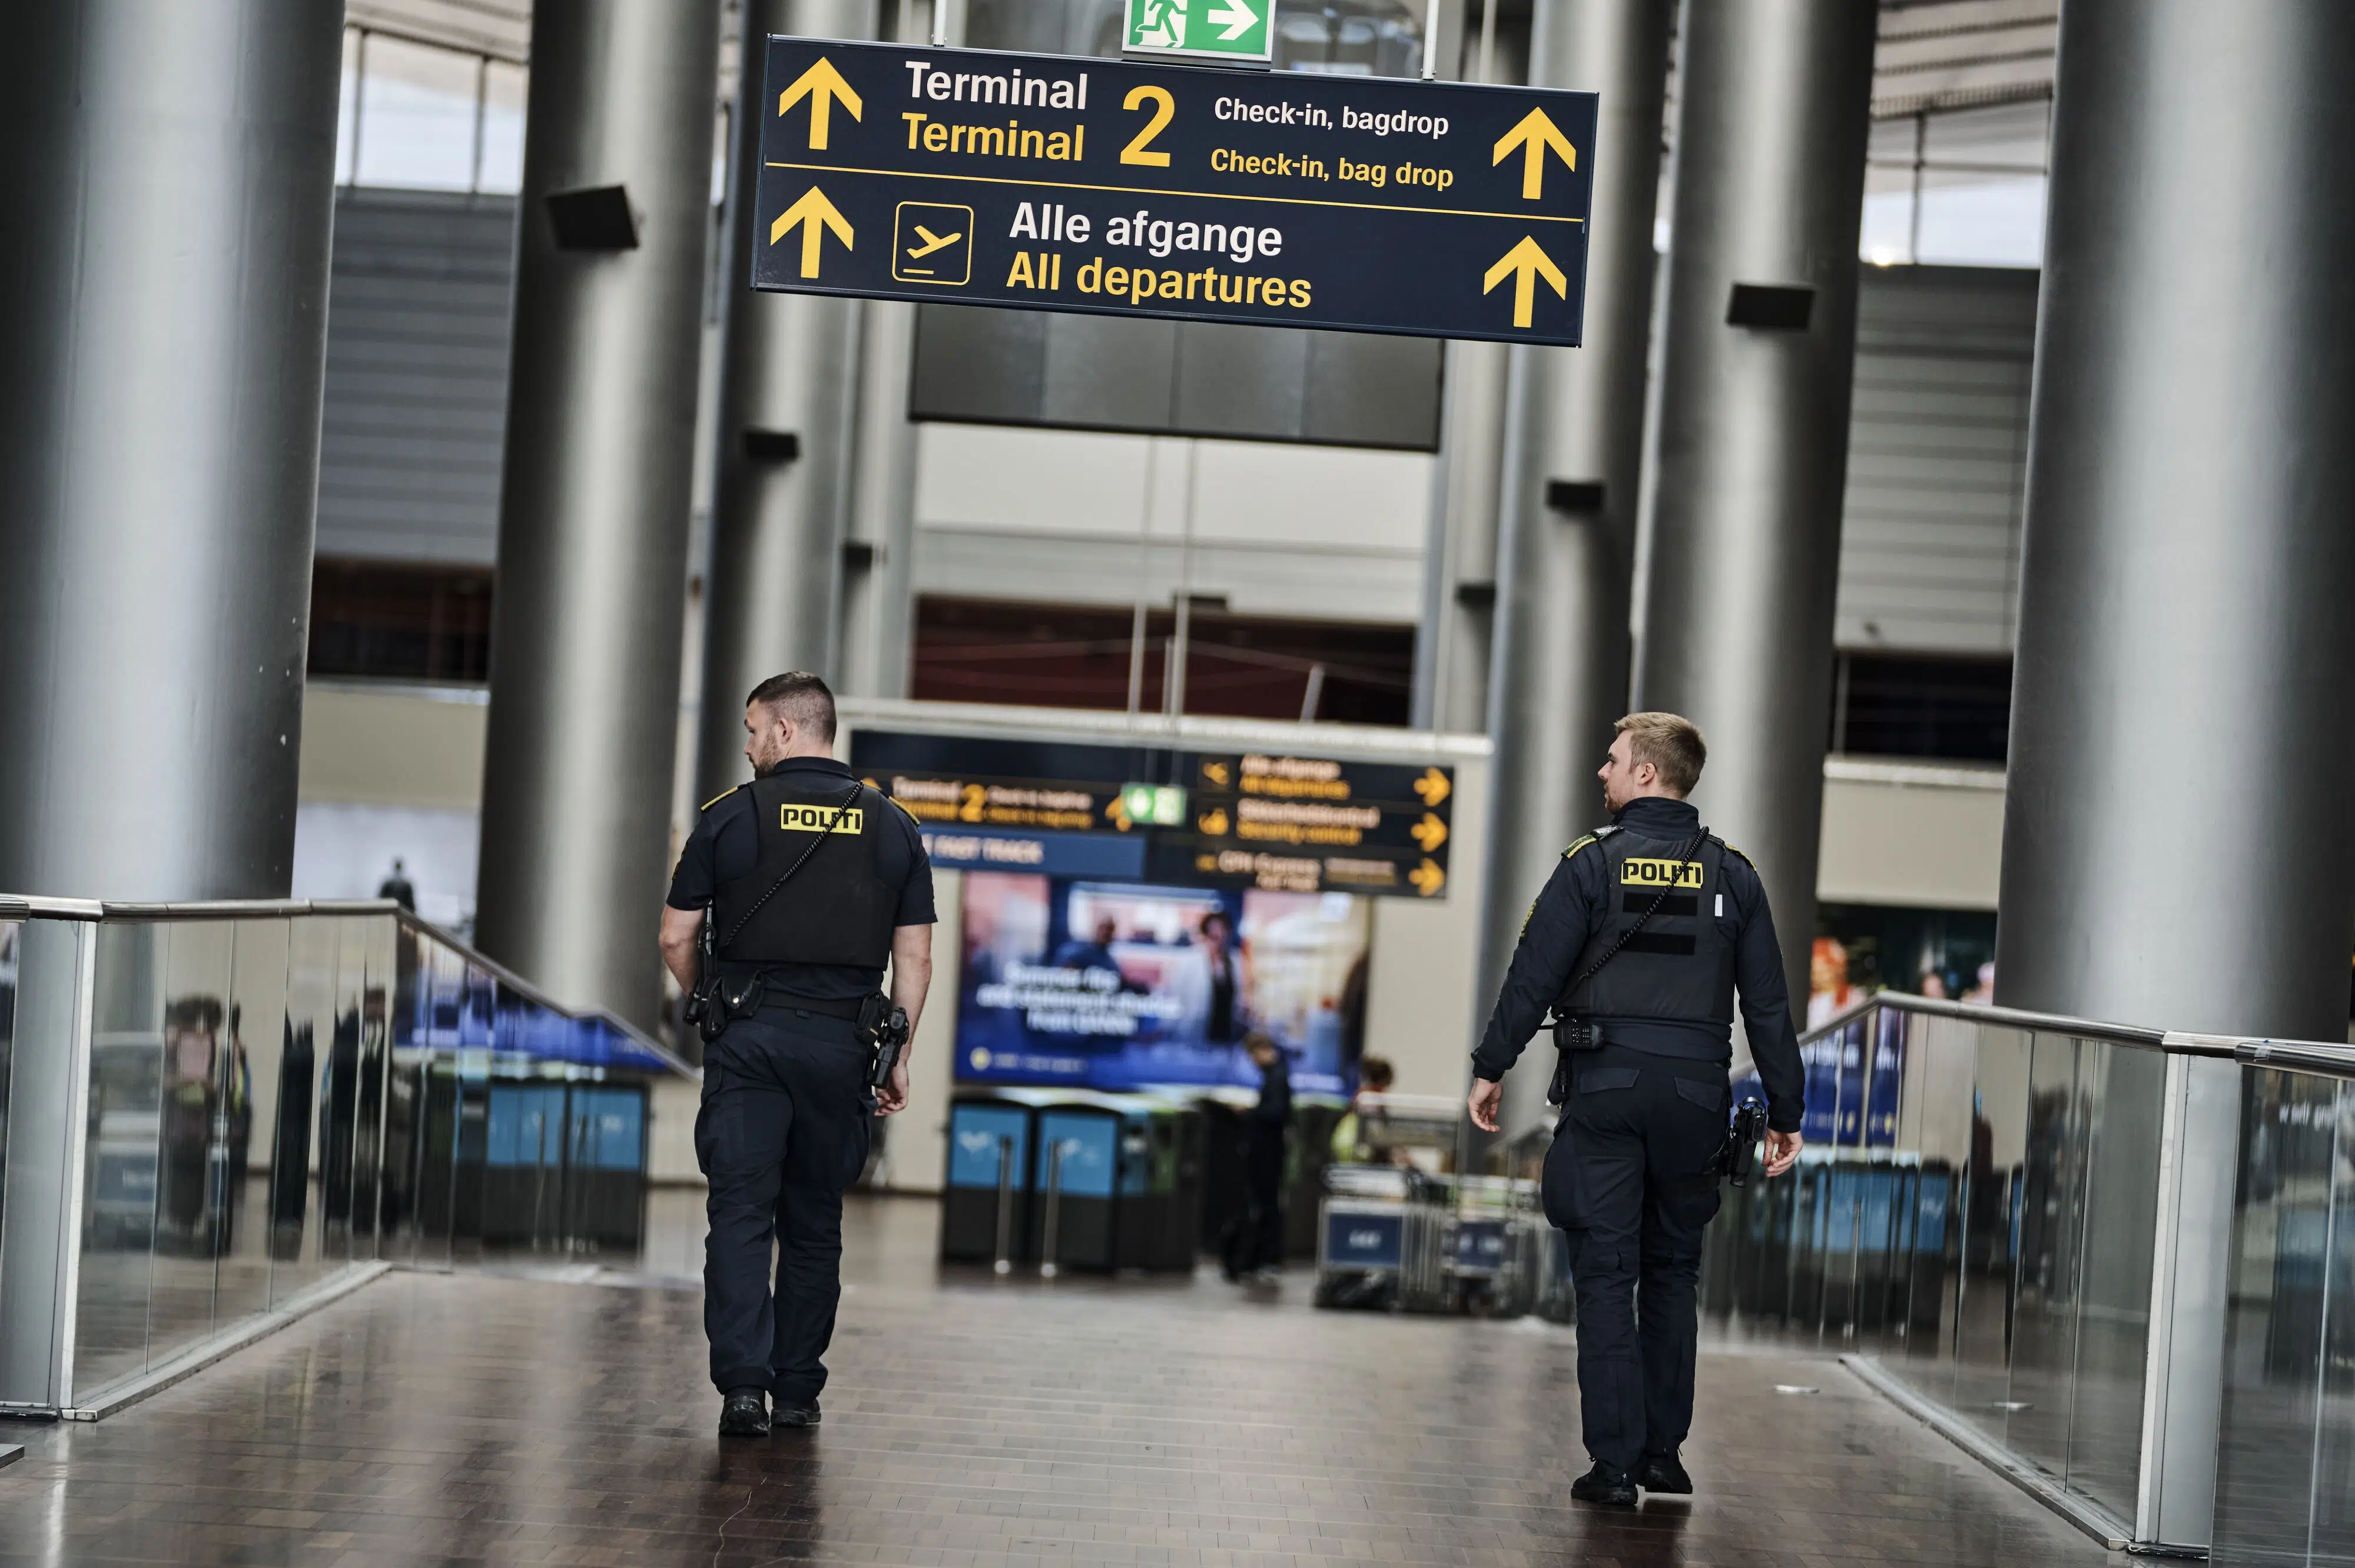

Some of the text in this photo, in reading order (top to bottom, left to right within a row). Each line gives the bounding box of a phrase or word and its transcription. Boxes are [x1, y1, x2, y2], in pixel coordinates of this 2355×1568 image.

[905, 59, 1089, 111] Terminal
[902, 112, 1084, 161] Terminal
[1120, 86, 1175, 167] 2
[1215, 97, 1448, 139] Check-in, bagdrop
[1211, 149, 1452, 191] Check-in, bag drop
[1009, 201, 1282, 263] Alle afgange
[1007, 251, 1310, 308] All departures
[962, 785, 987, 822] 2
